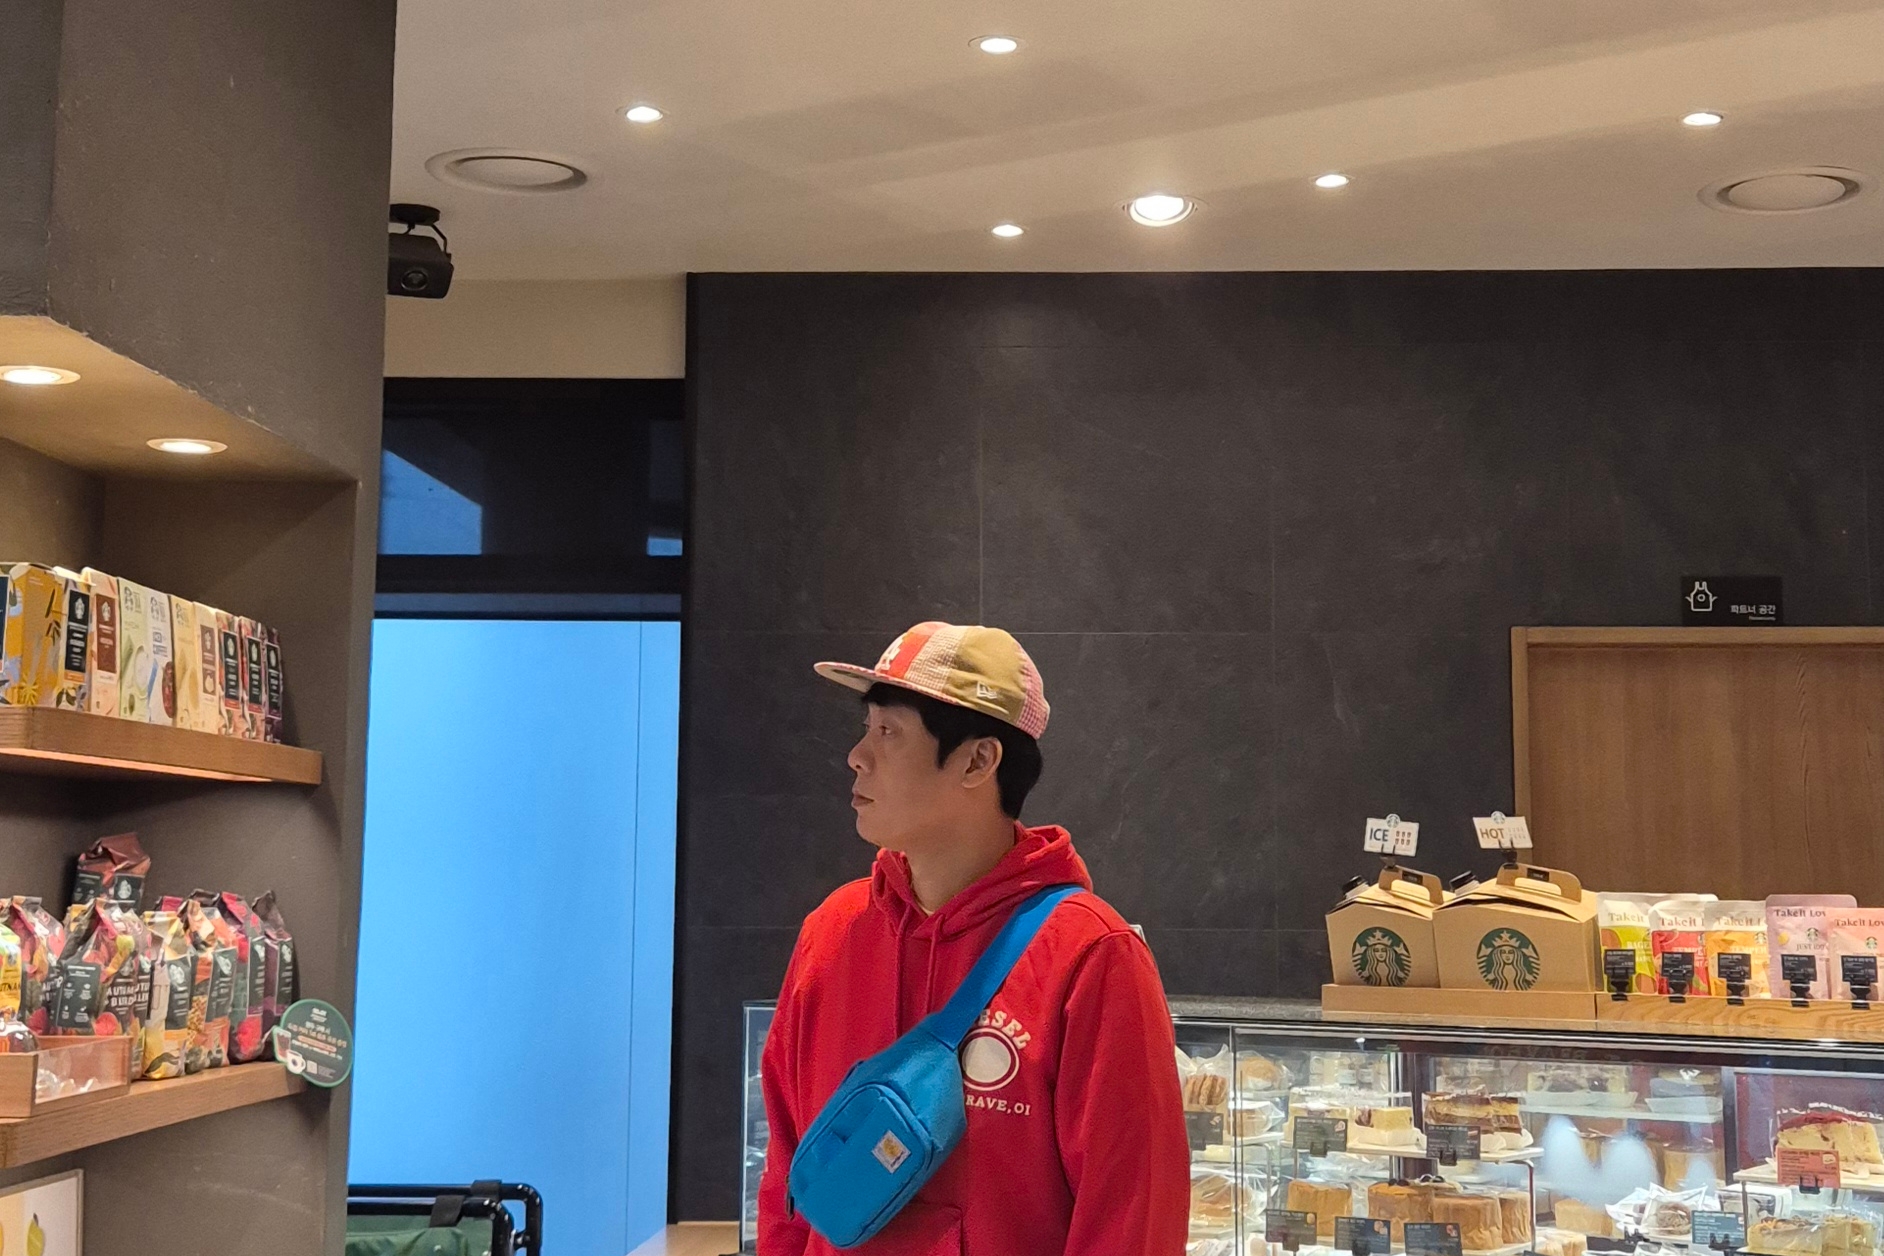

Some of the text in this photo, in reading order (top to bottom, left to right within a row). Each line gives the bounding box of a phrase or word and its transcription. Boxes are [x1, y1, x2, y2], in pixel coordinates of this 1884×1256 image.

[1730, 604, 1776, 615] 파트너 공간
[1369, 827, 1389, 842] ICE
[1479, 827, 1505, 840] HOT
